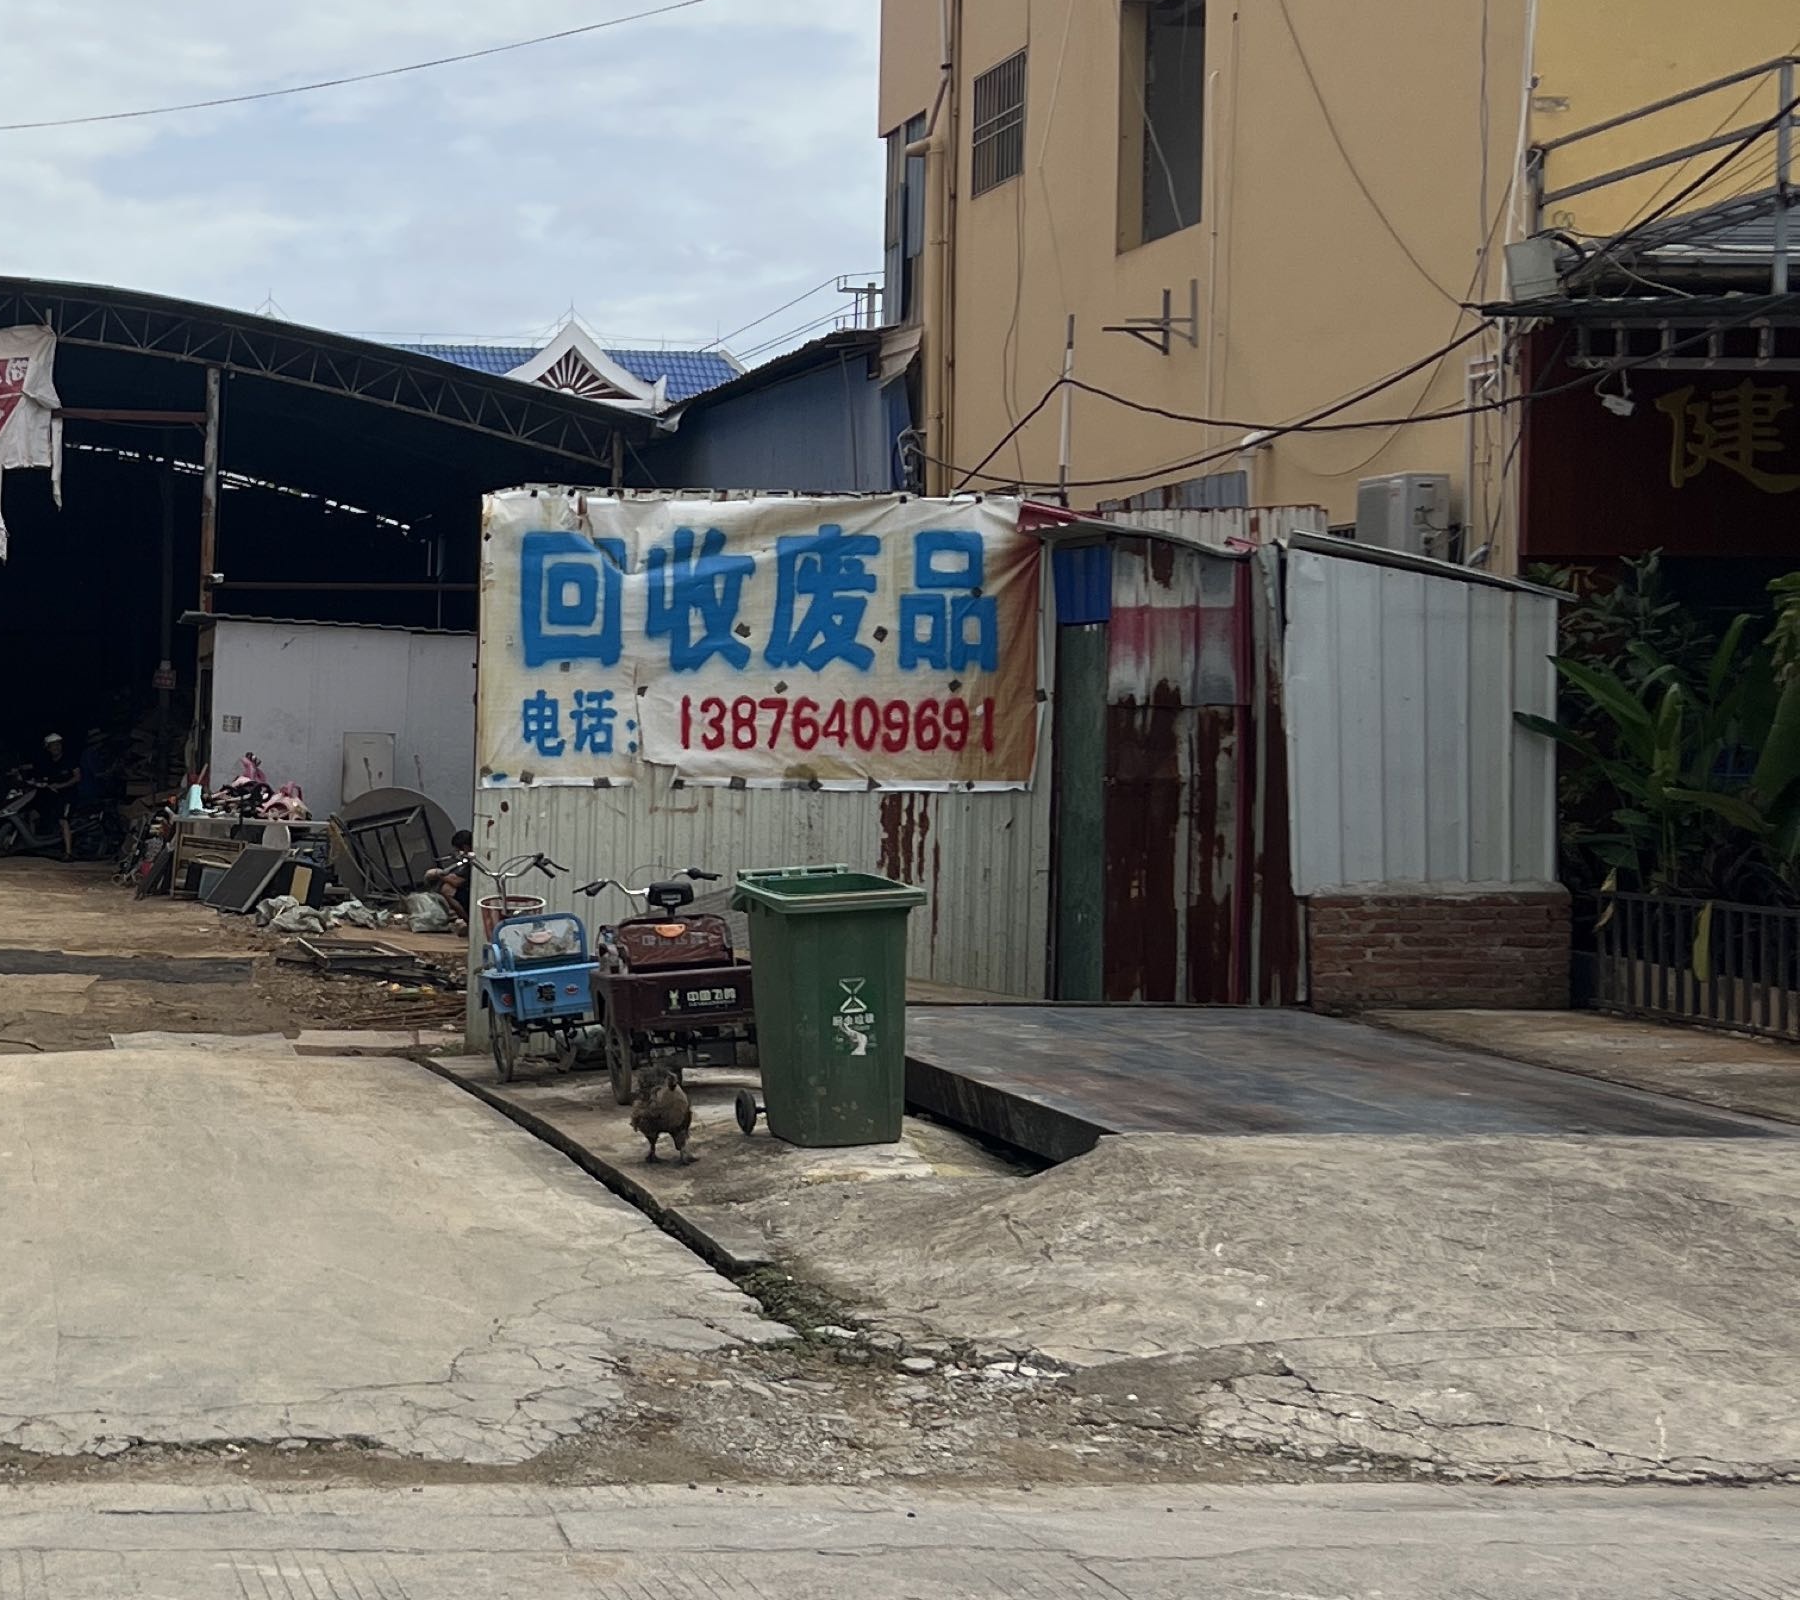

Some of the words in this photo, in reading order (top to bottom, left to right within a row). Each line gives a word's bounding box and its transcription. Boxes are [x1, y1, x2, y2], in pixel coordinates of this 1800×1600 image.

[1653, 376, 1800, 495] 健
[518, 523, 1000, 673] 回收废品
[678, 694, 997, 754] 13876409691
